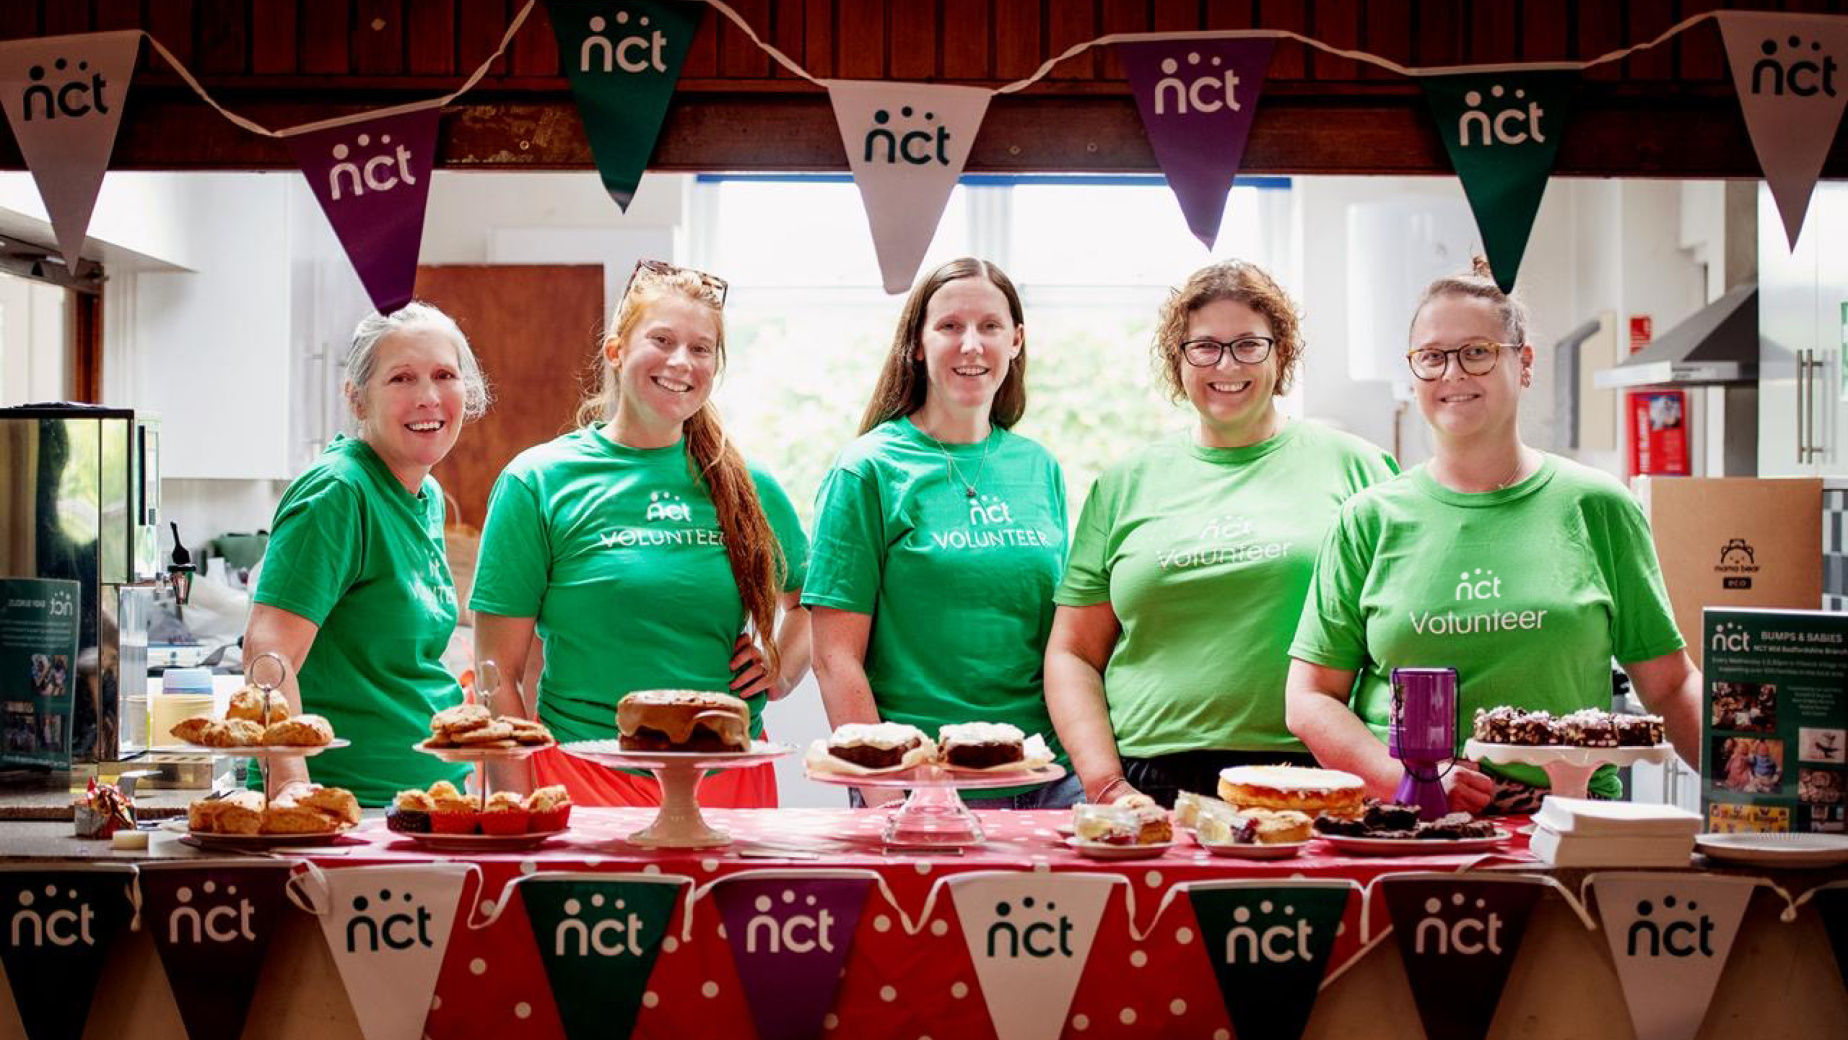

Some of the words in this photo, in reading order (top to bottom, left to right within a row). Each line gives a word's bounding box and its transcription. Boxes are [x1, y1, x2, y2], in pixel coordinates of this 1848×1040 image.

[581, 31, 666, 73] nct
[23, 73, 108, 121] nct
[1155, 70, 1240, 115] nct
[1752, 56, 1838, 97] nct
[1460, 102, 1546, 147] nct
[864, 126, 950, 167] nct
[330, 145, 416, 200] nct
[647, 502, 691, 522] nct
[969, 501, 1013, 525] nct
[931, 528, 1052, 549] VOLUNTEER
[1156, 540, 1292, 569] Volunteer
[1455, 576, 1502, 601] nct
[1727, 579, 1747, 587] eco
[1408, 608, 1548, 635] Volunteer
[1711, 631, 1750, 652] nct
[1761, 631, 1796, 643] BUMPS
[1807, 632, 1843, 644] BABIES
[12, 904, 95, 946] nct
[170, 899, 256, 942] nct
[347, 906, 433, 953] nct
[555, 913, 643, 957] nct
[746, 909, 834, 953] nct
[987, 915, 1074, 958] nct
[1226, 919, 1313, 964] nct
[1416, 913, 1502, 955] nct
[1627, 915, 1715, 957] nct
